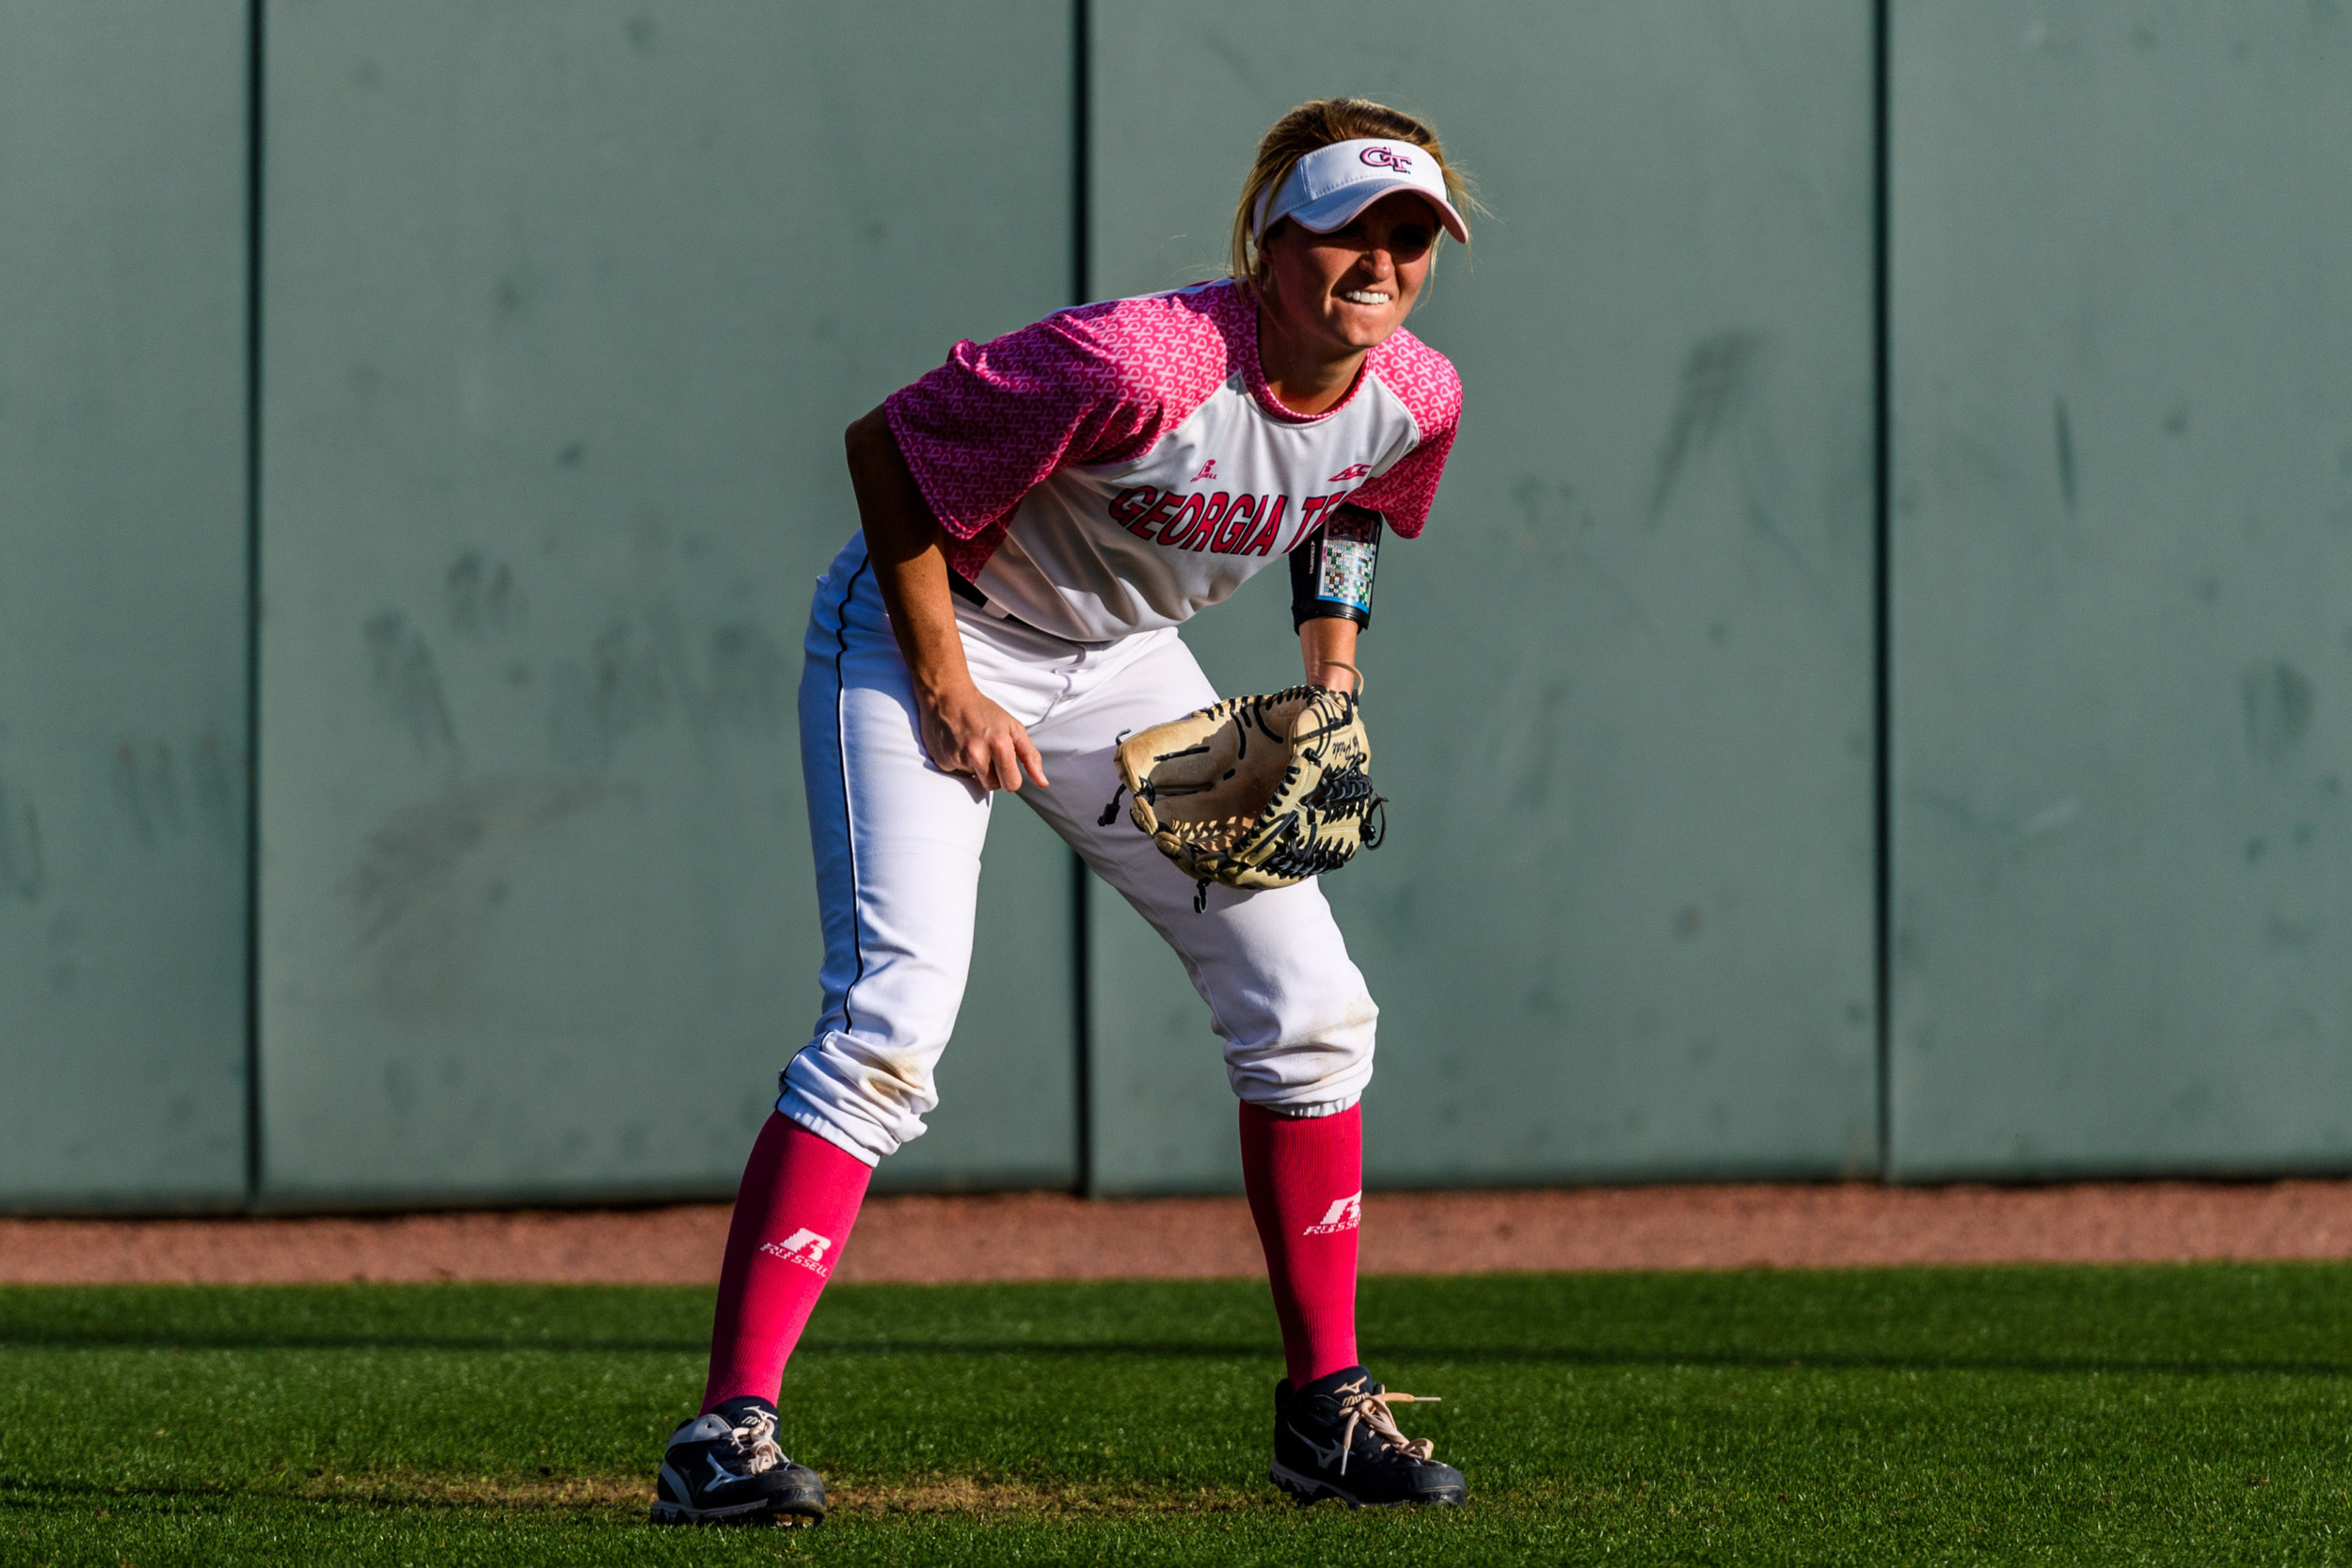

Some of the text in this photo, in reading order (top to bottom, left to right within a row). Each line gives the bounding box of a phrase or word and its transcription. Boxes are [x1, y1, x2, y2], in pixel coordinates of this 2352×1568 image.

[1108, 485, 1346, 556] GEORGIA TE
[759, 1243, 828, 1277] RUSSELL
